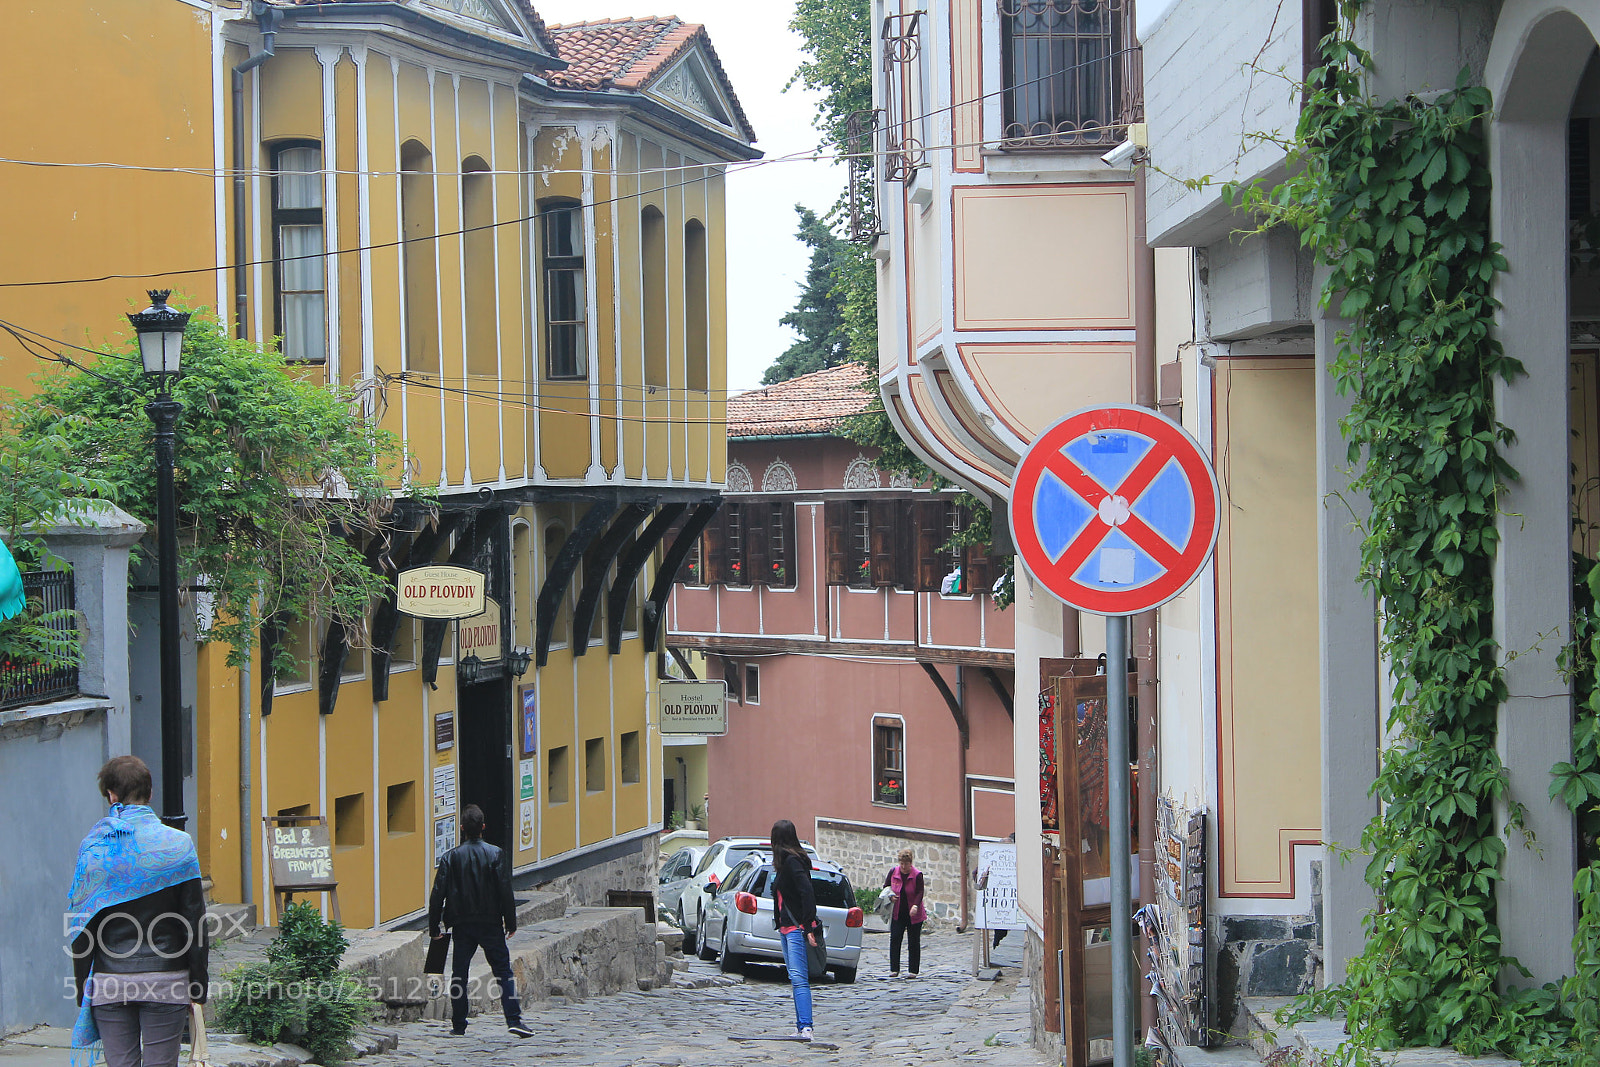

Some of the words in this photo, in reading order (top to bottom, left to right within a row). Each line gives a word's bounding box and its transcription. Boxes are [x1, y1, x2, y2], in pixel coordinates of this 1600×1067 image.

[404, 585, 427, 598] OLD
[430, 585, 476, 598] PLOVDIV
[460, 627, 473, 649] OLD
[473, 624, 498, 648] PLOVDIV
[664, 704, 682, 715] OLD
[684, 704, 719, 715] PLOVDIV
[275, 828, 298, 844] Bed
[301, 828, 314, 846] &
[287, 860, 312, 872] FROM
